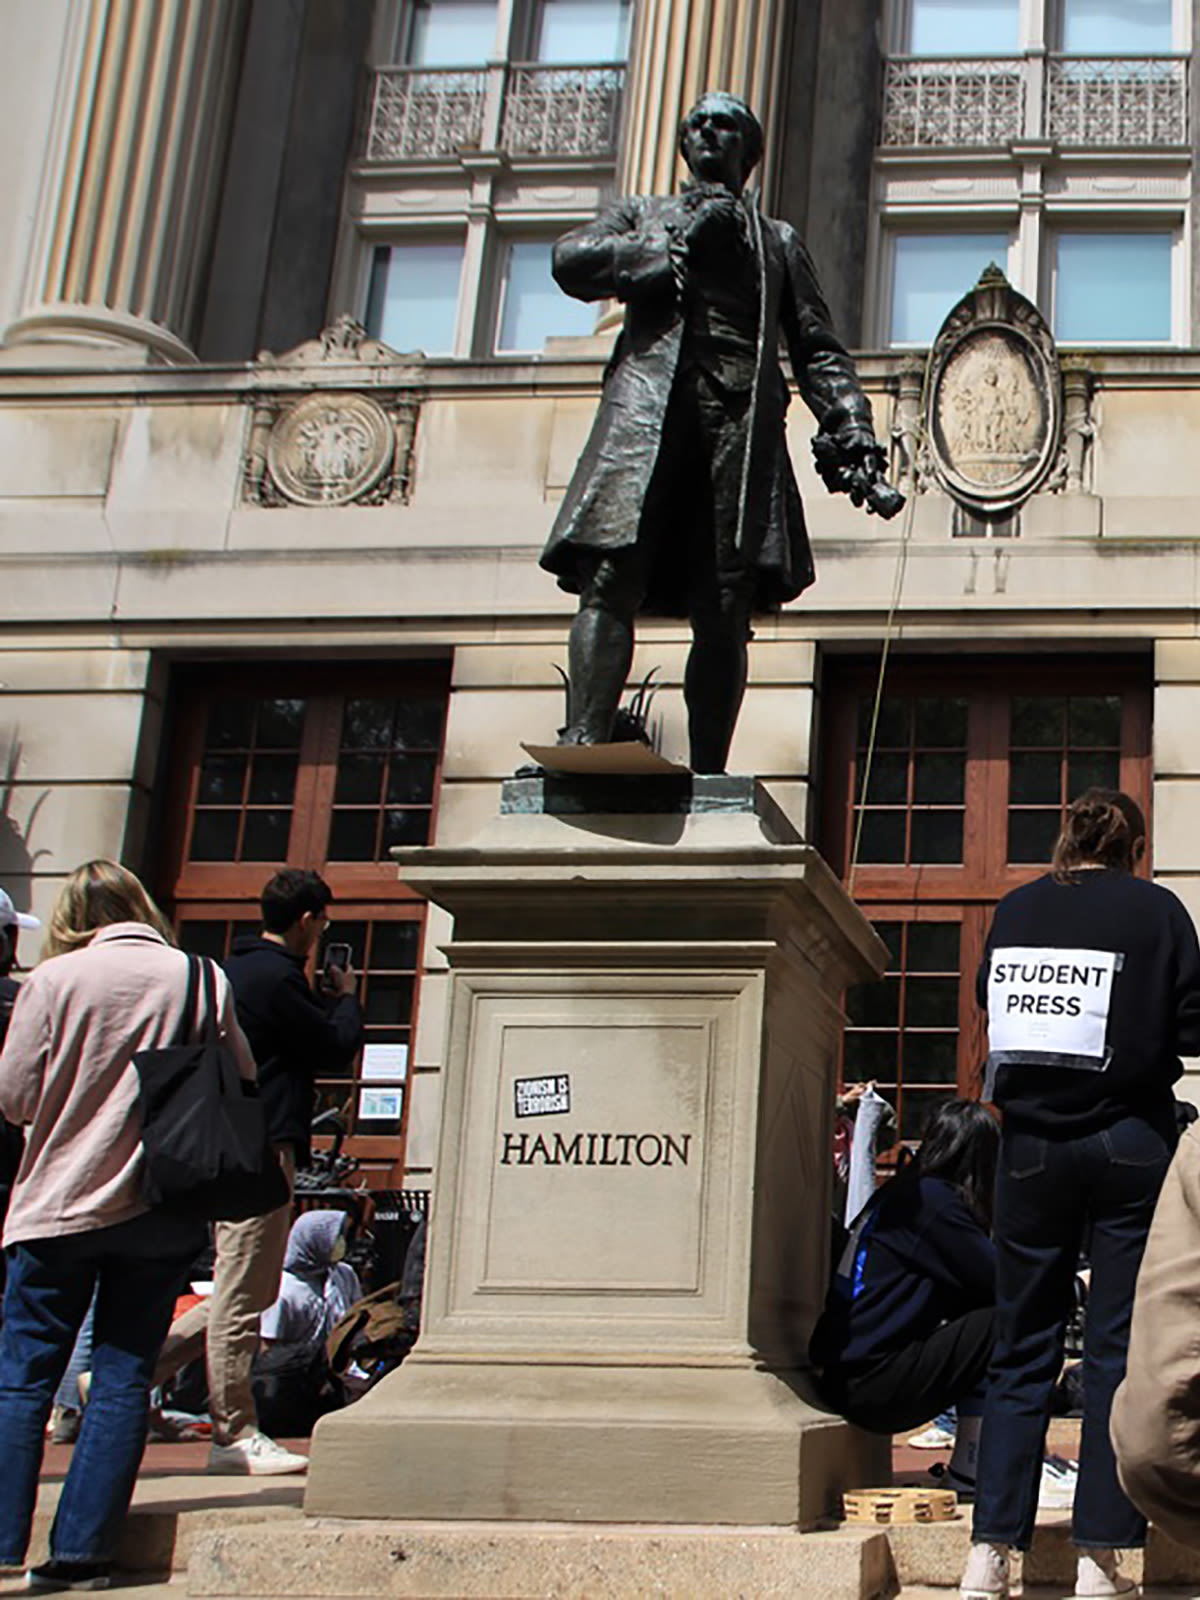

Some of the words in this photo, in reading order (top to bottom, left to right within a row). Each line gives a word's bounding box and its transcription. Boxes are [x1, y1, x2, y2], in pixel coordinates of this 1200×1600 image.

[994, 963, 1108, 987] STUDENT
[1006, 994, 1081, 1017] PRESS
[500, 1132, 692, 1167] HAMILTON
